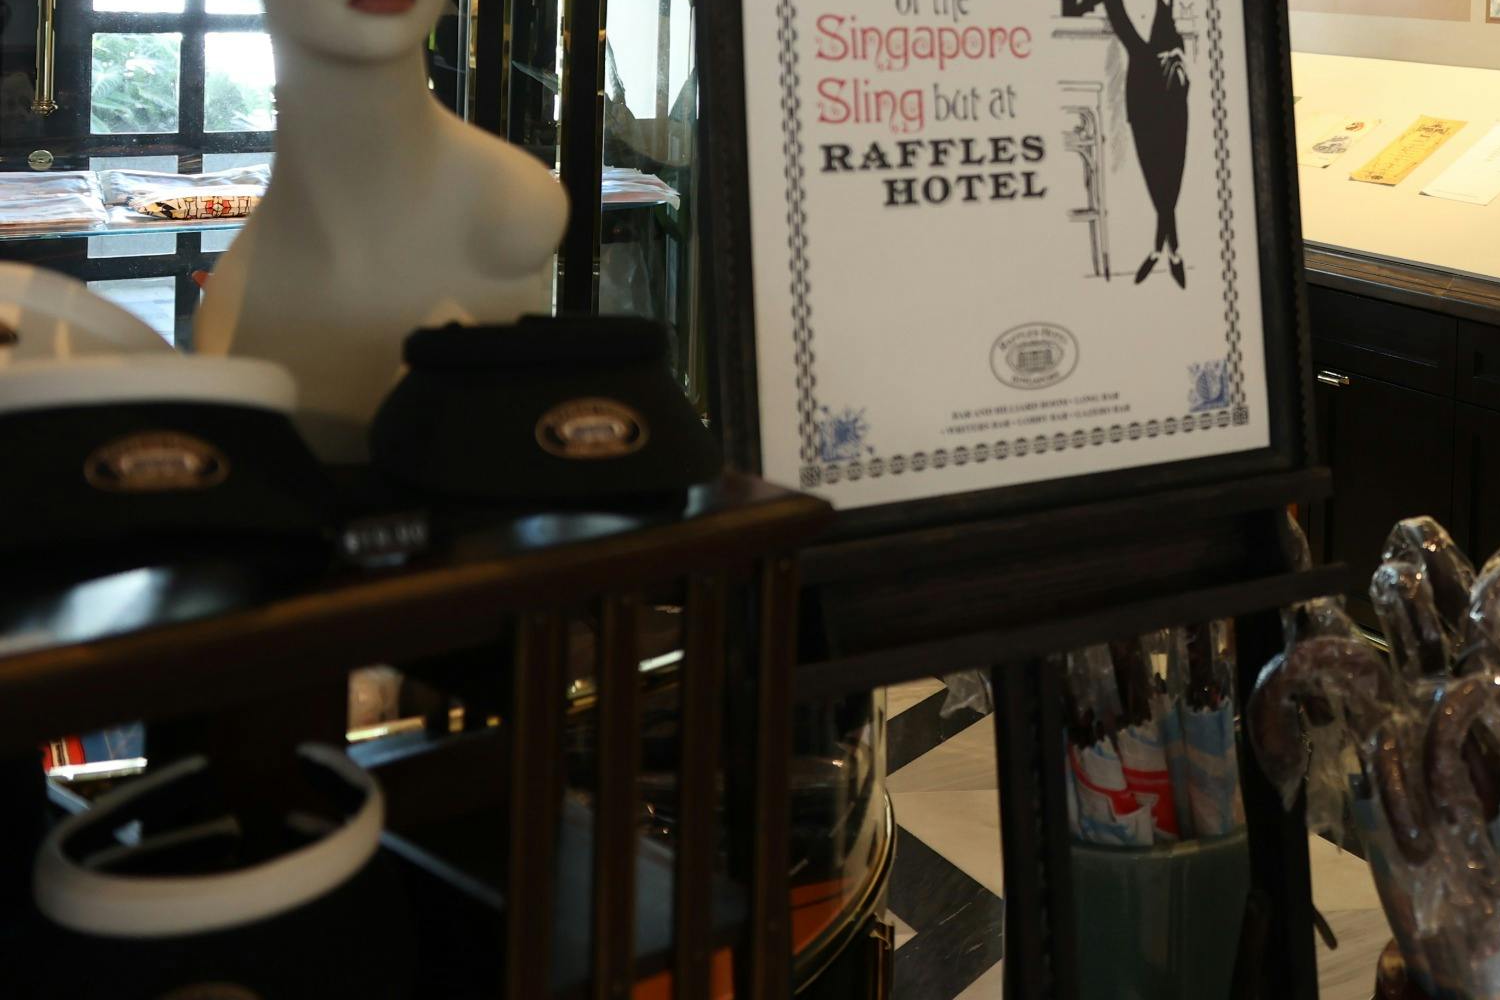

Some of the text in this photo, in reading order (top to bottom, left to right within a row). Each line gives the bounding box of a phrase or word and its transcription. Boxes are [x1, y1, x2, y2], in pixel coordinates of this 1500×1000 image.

[815, 13, 1033, 73] Singapore
[815, 77, 1016, 135] Sling but at
[819, 134, 1047, 174] RAFFLES
[883, 170, 1049, 208] HOTEL
